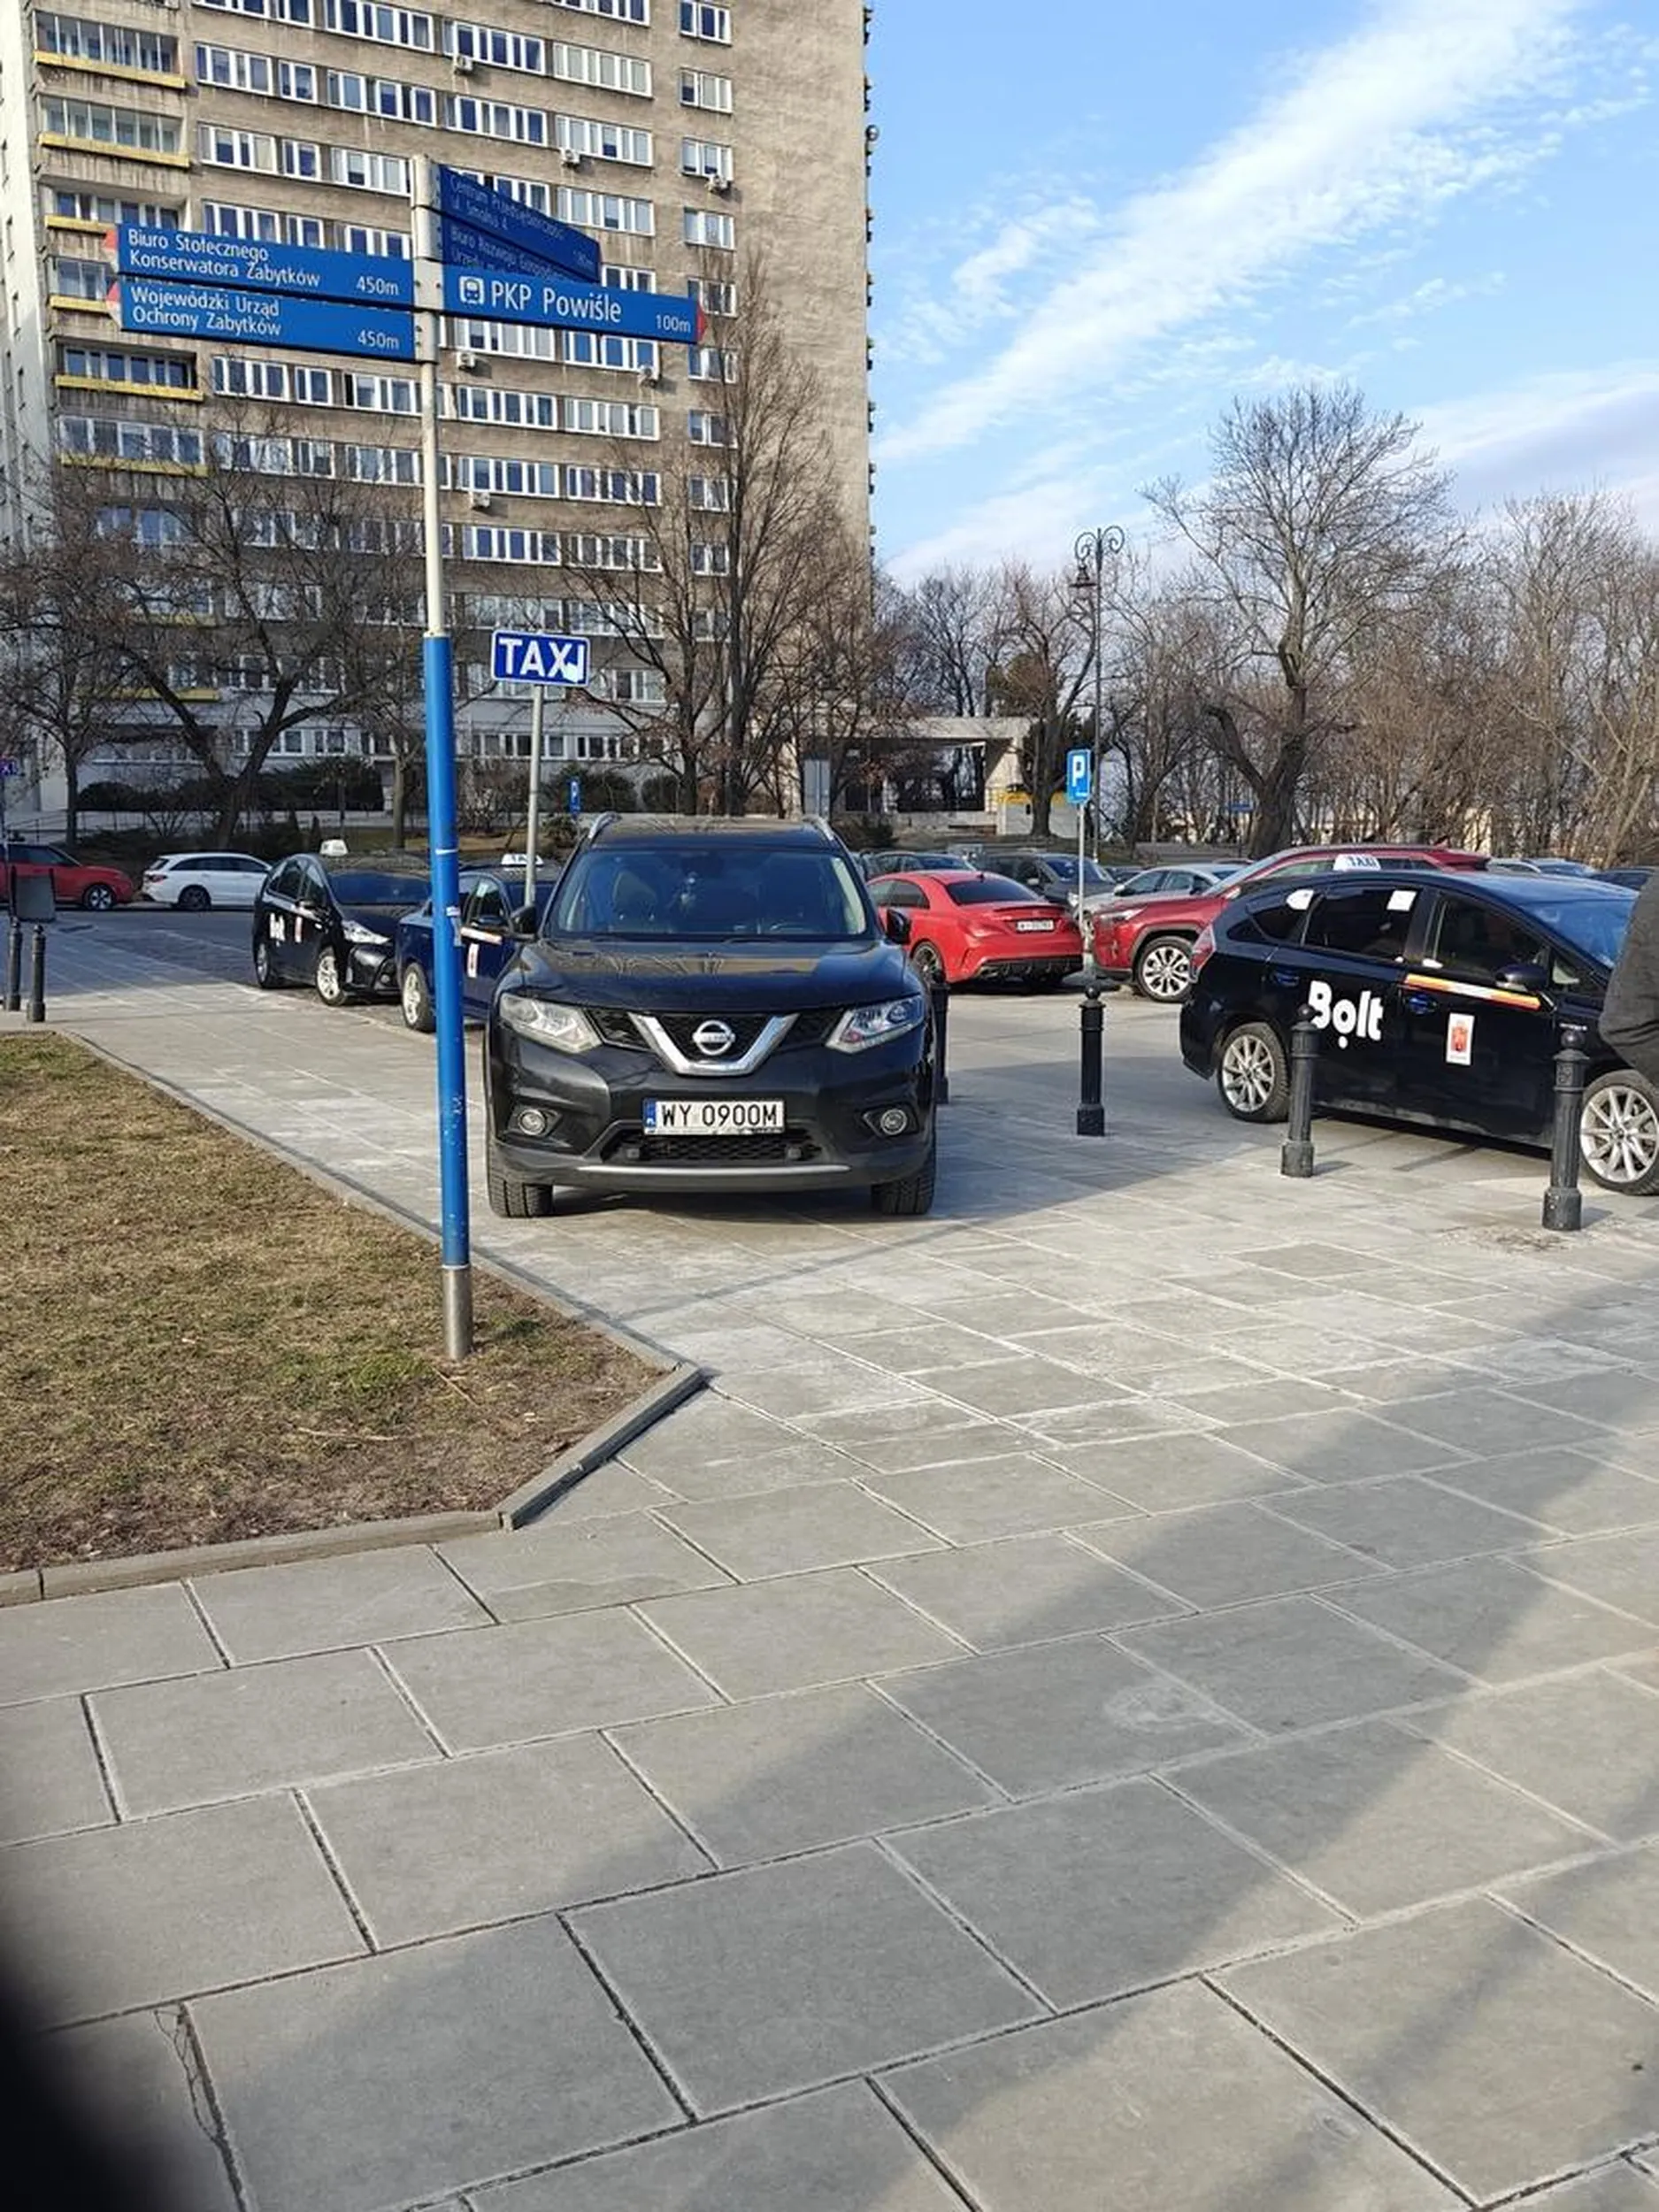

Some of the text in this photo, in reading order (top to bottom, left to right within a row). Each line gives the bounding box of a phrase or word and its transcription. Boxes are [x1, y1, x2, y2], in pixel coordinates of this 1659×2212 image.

[128, 228, 269, 265] Biuro Stołecznego
[129, 250, 320, 288] Konserwatora Zabytków
[356, 276, 399, 296] 450m
[491, 280, 622, 323] PKP Powiśle
[131, 285, 280, 320] Wojewódzki Urząd
[133, 306, 281, 336] Ochrony Zabytków
[656, 314, 691, 334] 100m
[357, 329, 400, 350] 450m
[498, 637, 585, 682] TAXI
[1071, 755, 1086, 787] P
[1347, 855, 1379, 868] TAXI
[1309, 979, 1384, 1049] Bolt
[662, 1104, 691, 1126] WY
[703, 1104, 777, 1127] 0900M
